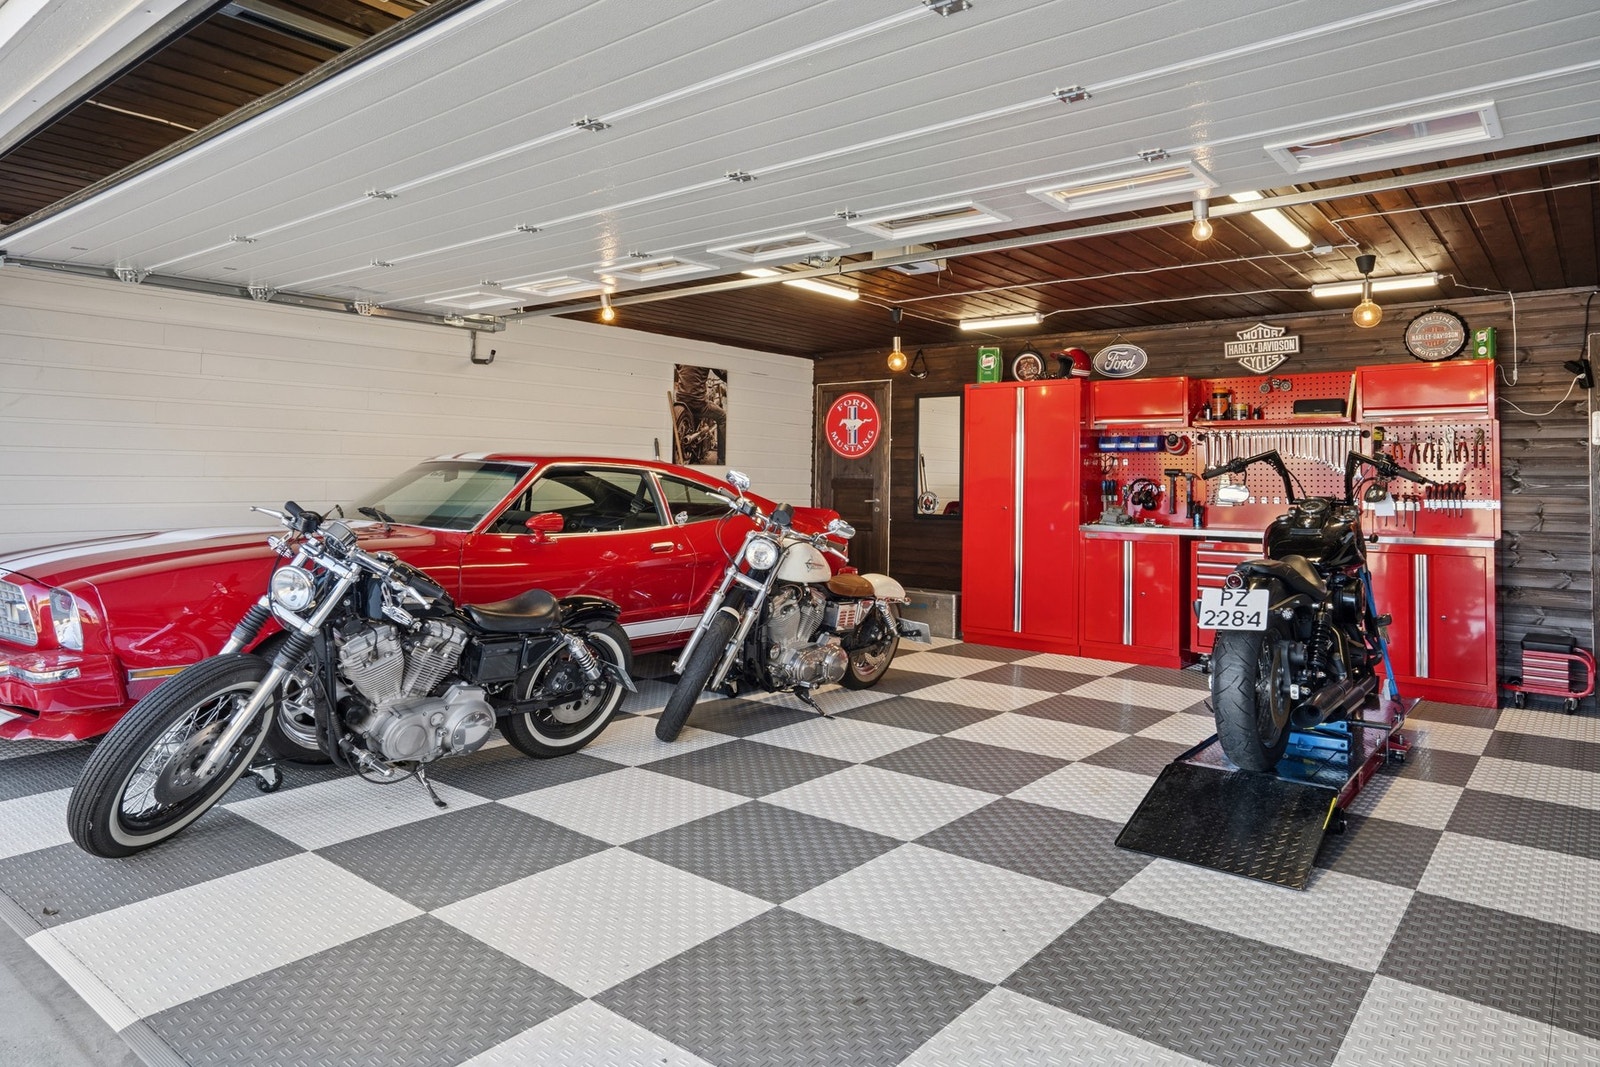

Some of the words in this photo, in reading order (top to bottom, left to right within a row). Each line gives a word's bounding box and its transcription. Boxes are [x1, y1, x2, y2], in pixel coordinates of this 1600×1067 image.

[1243, 327, 1278, 340] MOTOR
[1228, 339, 1295, 355] HARLEY-DAVIDSON
[1441, 345, 1456, 355] OIL
[1104, 350, 1136, 371] Ford
[1243, 354, 1279, 370] CYCLES
[837, 399, 868, 411] FORD
[831, 430, 874, 452] MUSTANG
[1220, 591, 1250, 607] PZ
[1204, 609, 1261, 627] 2284
